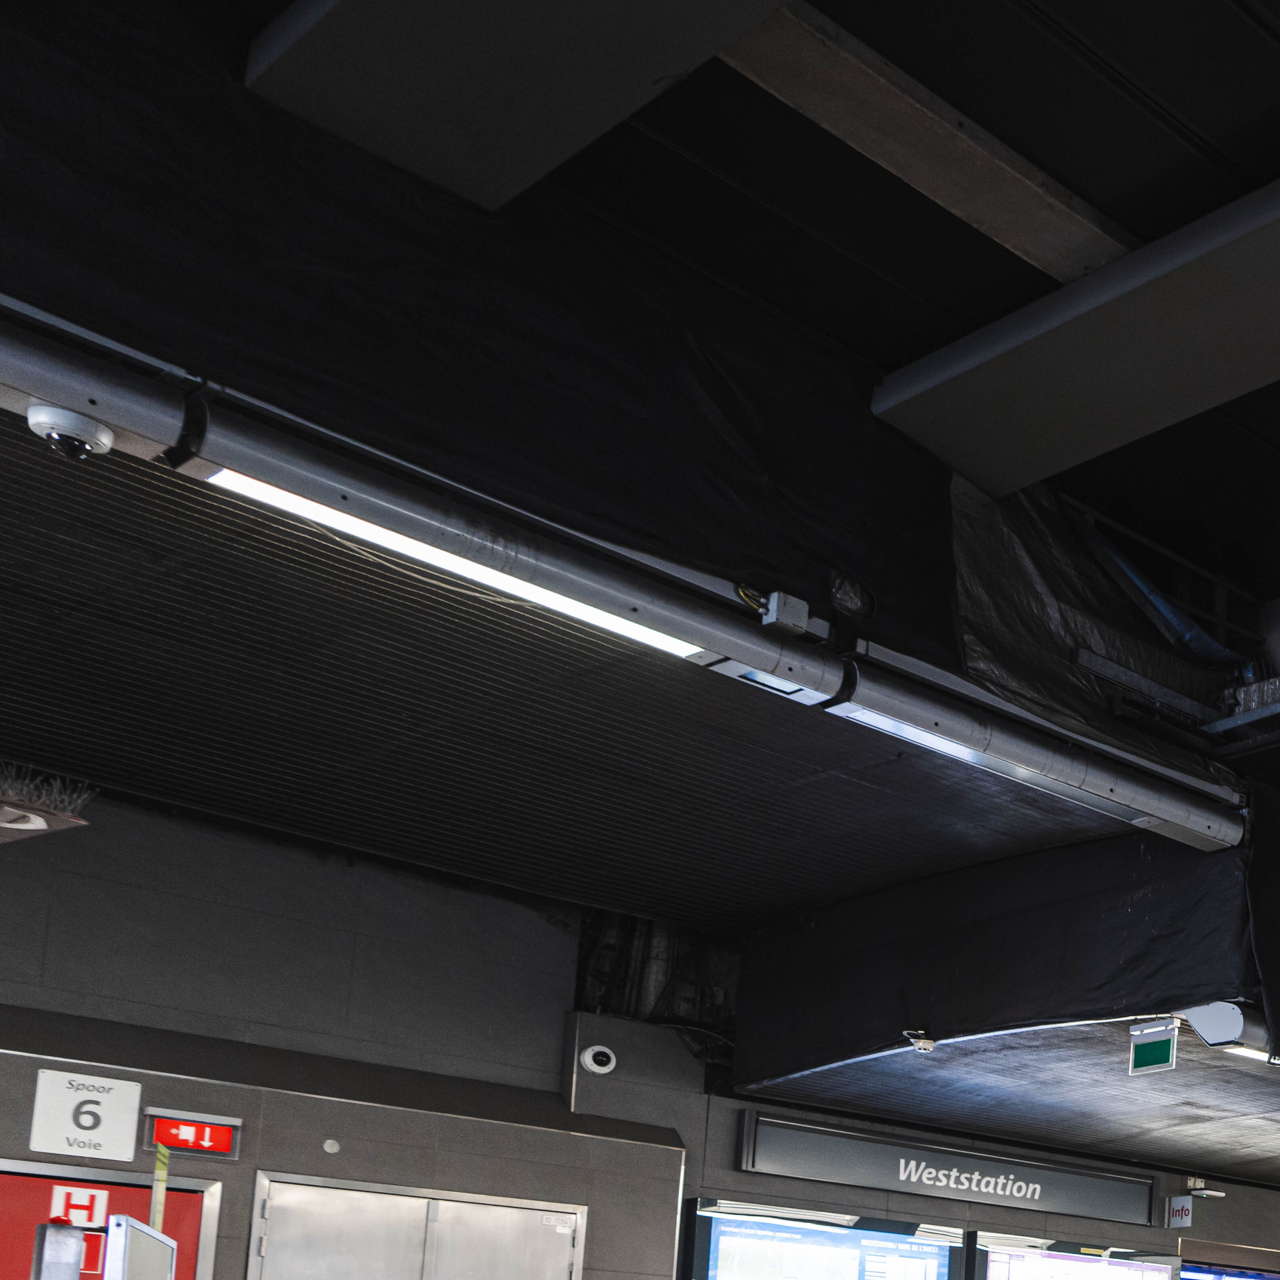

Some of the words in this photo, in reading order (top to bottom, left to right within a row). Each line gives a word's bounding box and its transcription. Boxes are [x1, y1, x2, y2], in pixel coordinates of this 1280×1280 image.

[66, 1079, 114, 1095] Spoor
[72, 1099, 101, 1131] 6
[66, 1136, 102, 1151] Voie
[899, 1158, 1041, 1200] Weststation
[63, 1191, 96, 1223] H
[1172, 1205, 1190, 1220] Info
